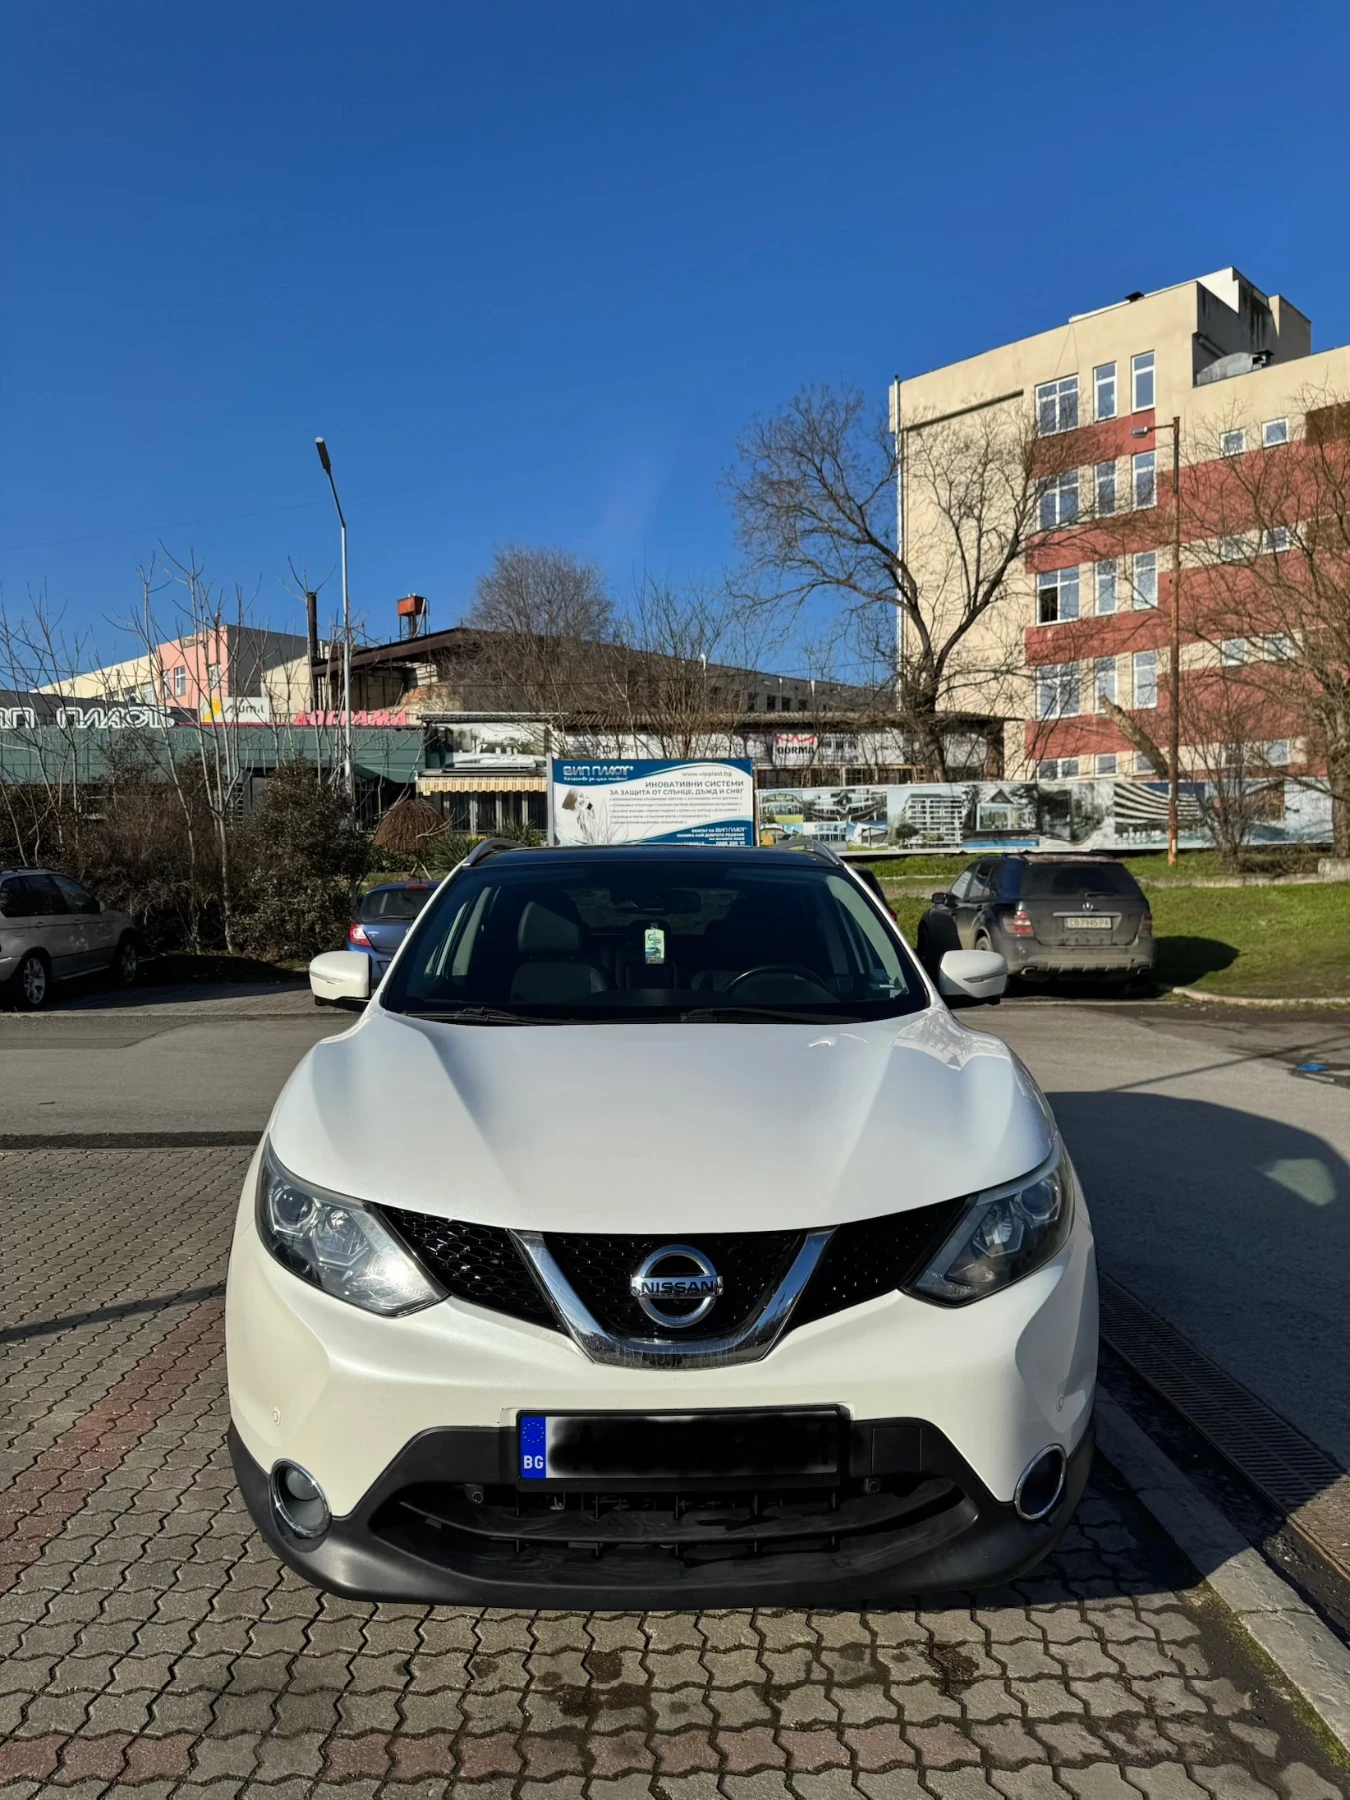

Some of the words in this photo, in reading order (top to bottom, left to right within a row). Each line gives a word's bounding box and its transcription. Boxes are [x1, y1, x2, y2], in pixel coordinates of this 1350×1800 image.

[563, 765, 590, 775] ВИП
[641, 1281, 714, 1293] NISSAN
[523, 1455, 544, 1469] BG
